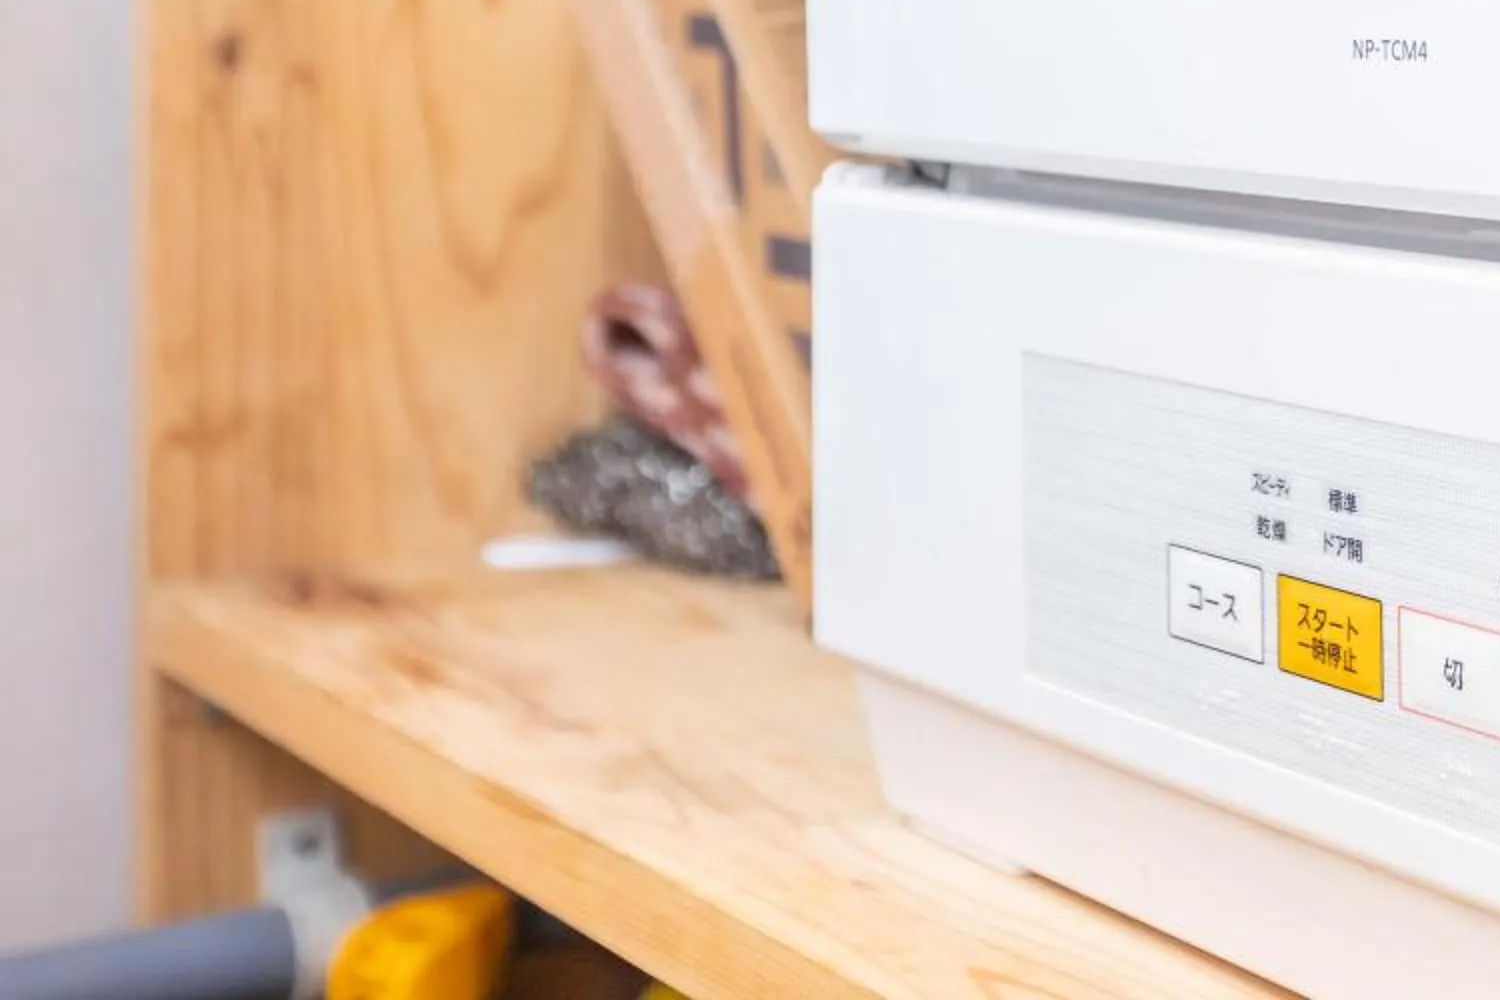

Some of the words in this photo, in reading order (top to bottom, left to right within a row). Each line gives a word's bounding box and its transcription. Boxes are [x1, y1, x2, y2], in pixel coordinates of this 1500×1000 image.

[1352, 38, 1428, 62] NP-TCM4
[1187, 583, 1239, 623] コース
[1297, 602, 1360, 643] スタート
[1297, 636, 1358, 675] 一時停止
[1443, 657, 1464, 692] 切
